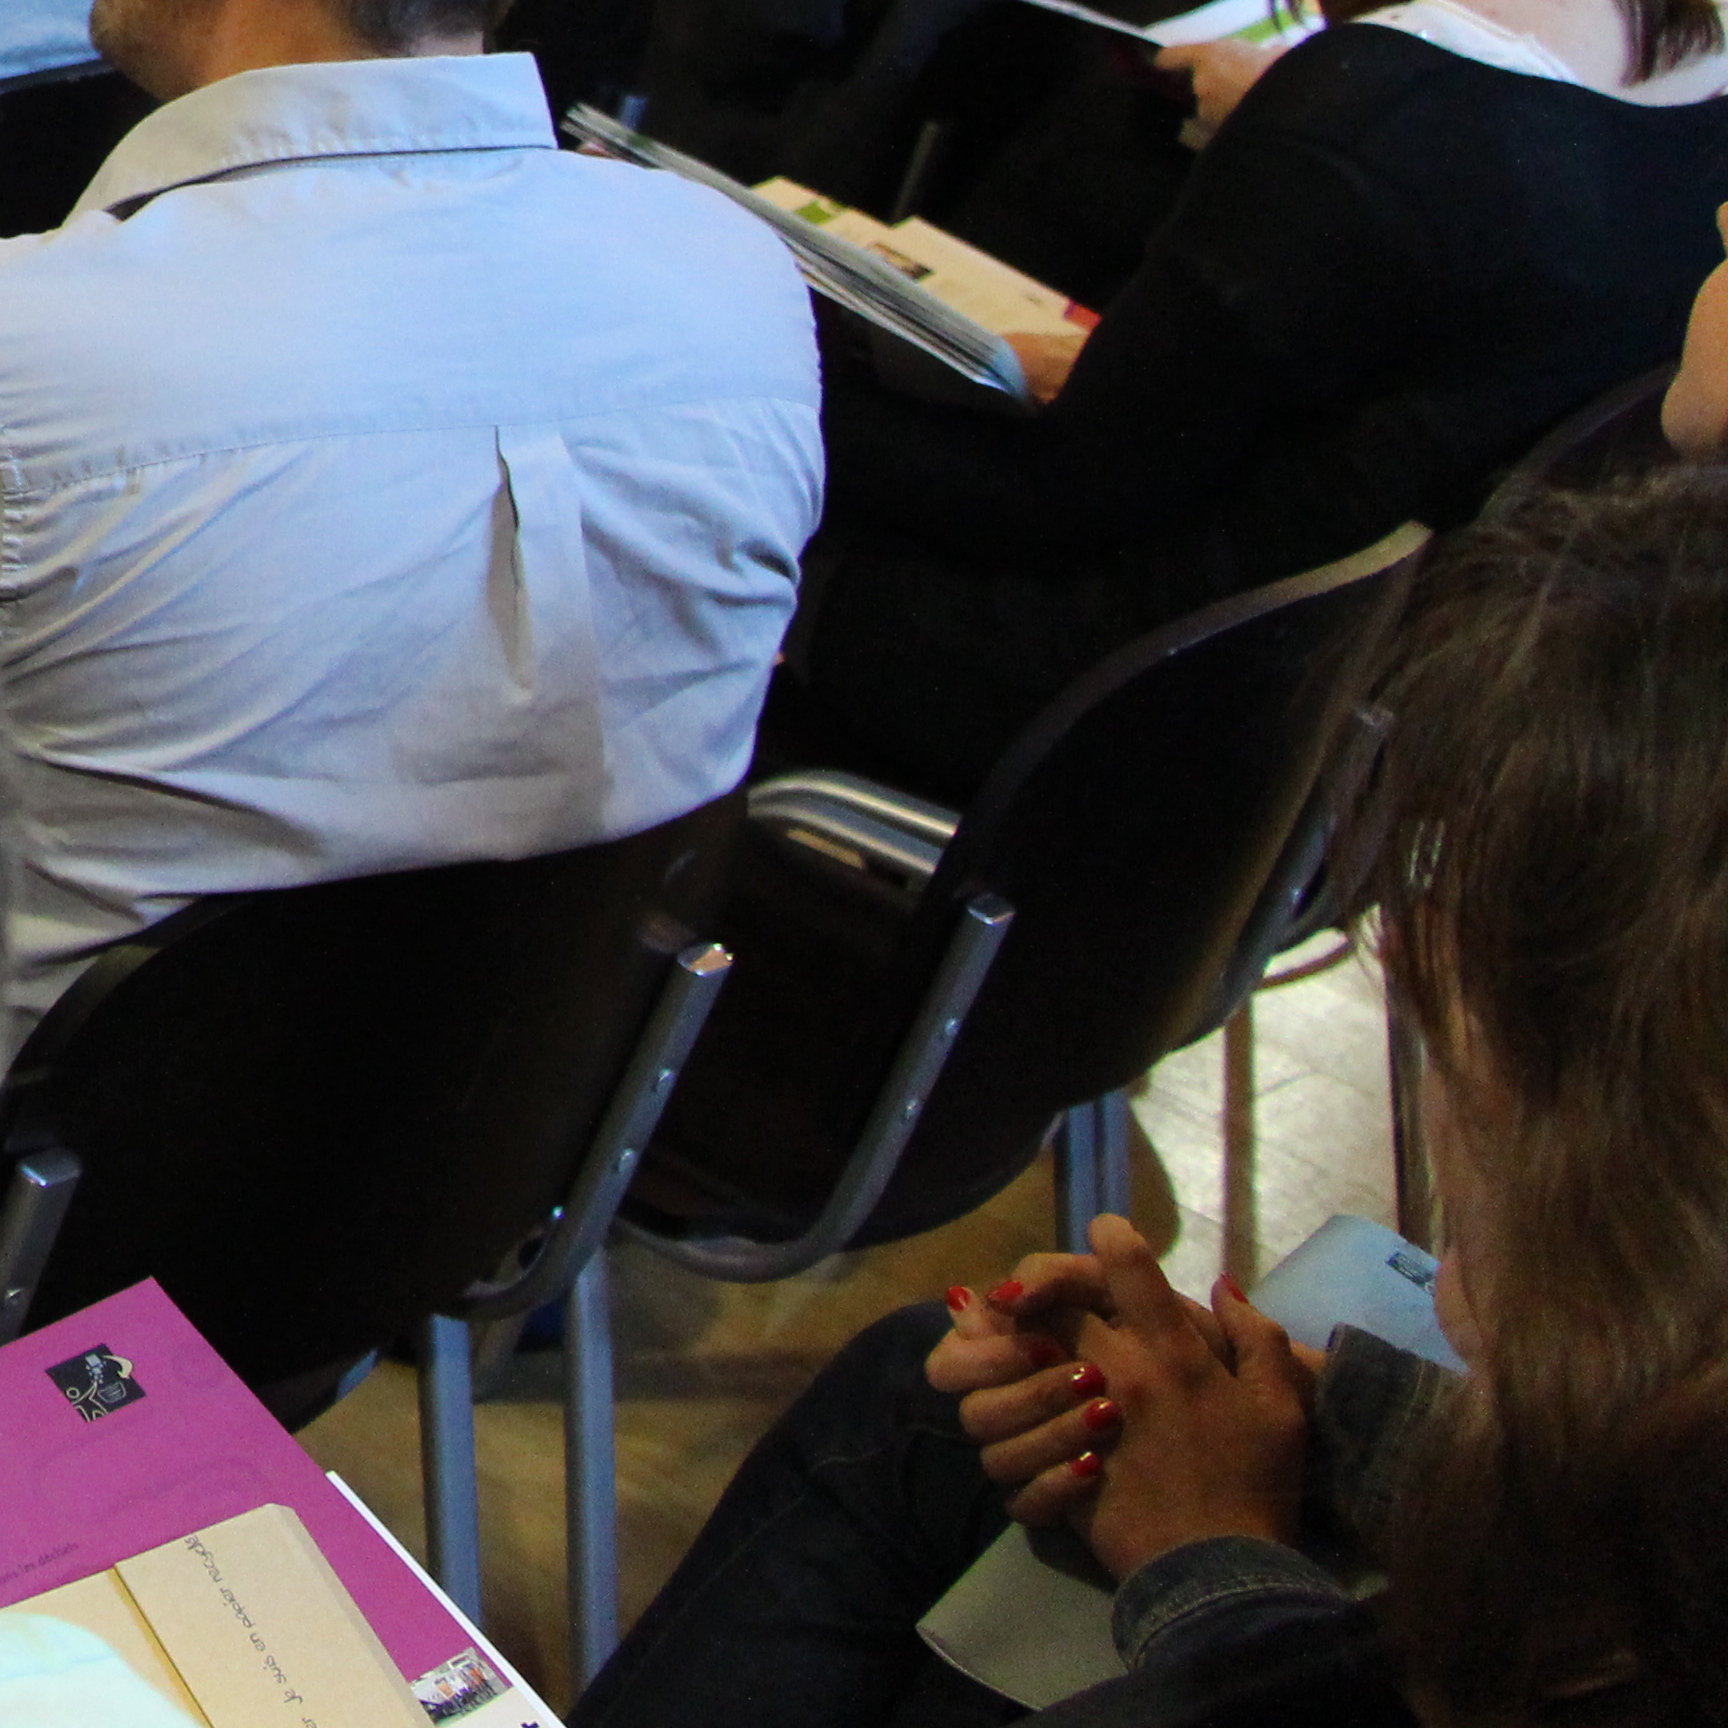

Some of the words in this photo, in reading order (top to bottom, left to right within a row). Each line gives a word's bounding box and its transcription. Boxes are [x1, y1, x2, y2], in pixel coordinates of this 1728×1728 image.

[219, 1587, 256, 1628] papier
[249, 1633, 266, 1652] en
[263, 1655, 287, 1683] suis
[283, 1688, 303, 1704] Je
